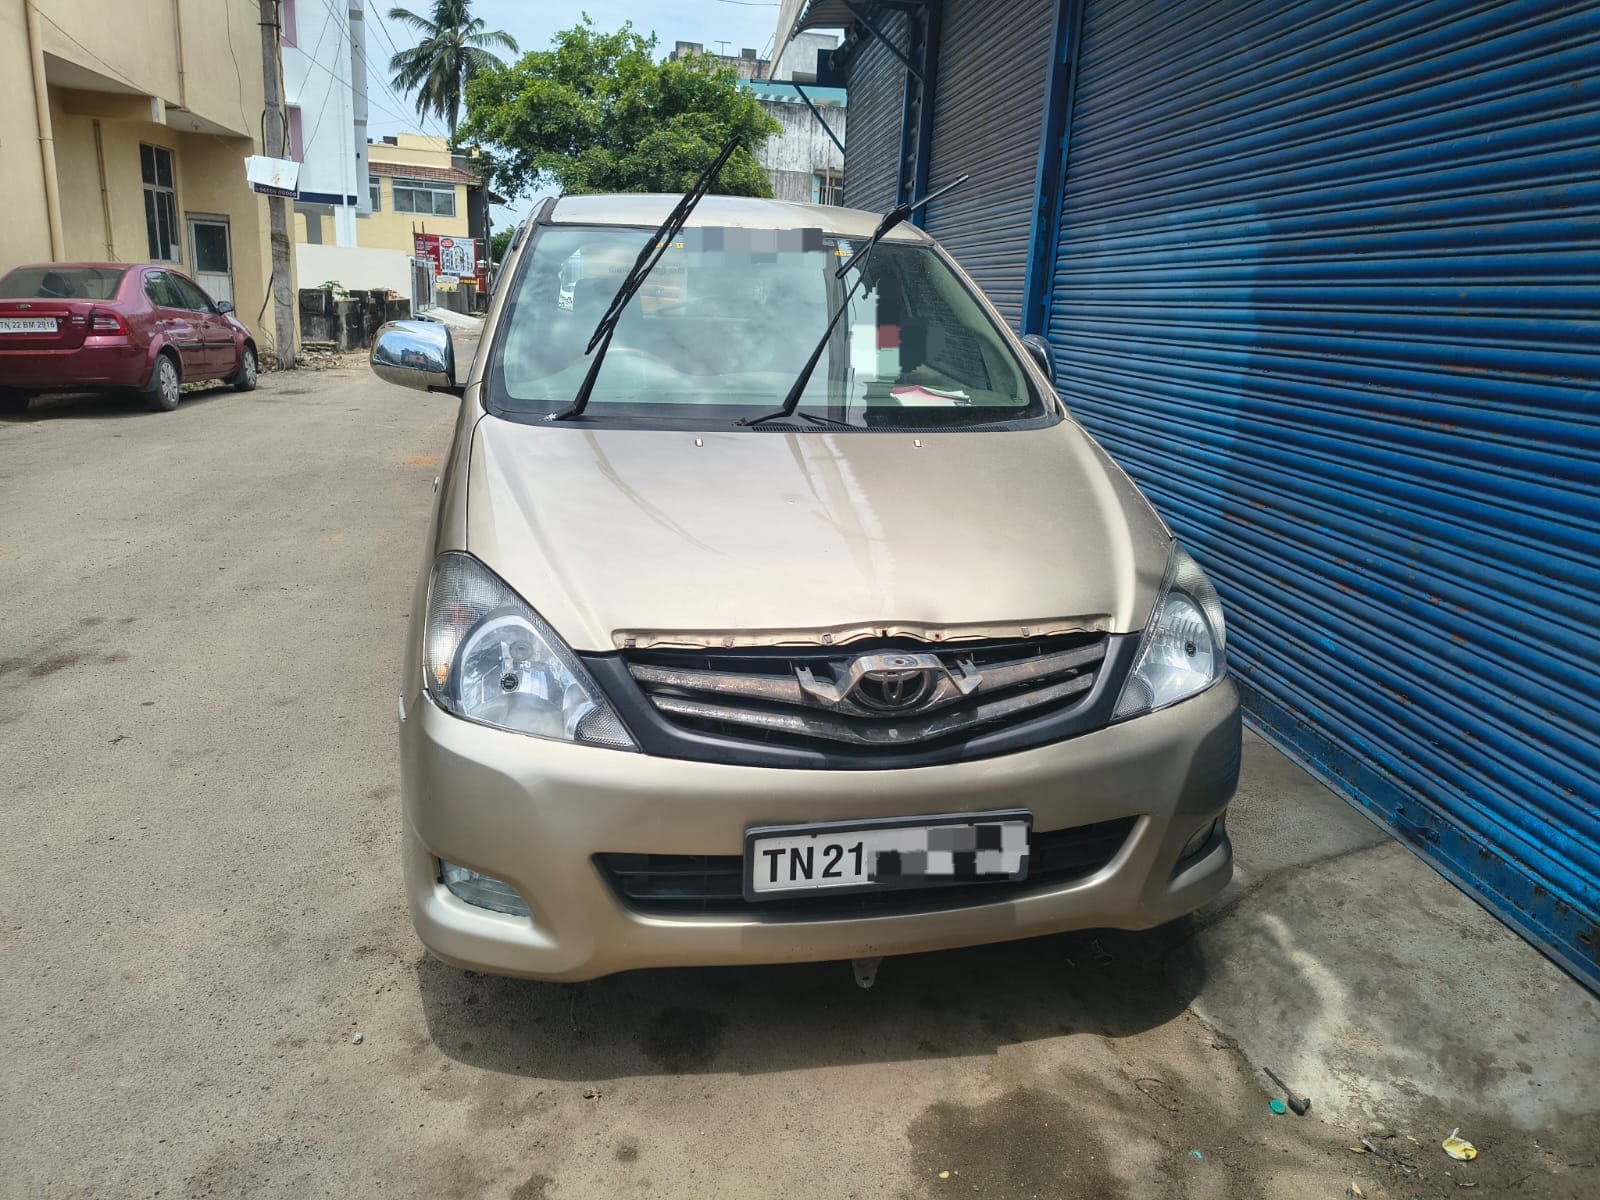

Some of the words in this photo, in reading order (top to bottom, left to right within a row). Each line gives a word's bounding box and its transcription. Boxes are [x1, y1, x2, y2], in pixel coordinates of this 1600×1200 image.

[0, 321, 10, 329] TN
[12, 321, 21, 329] 22
[23, 321, 35, 329] BM
